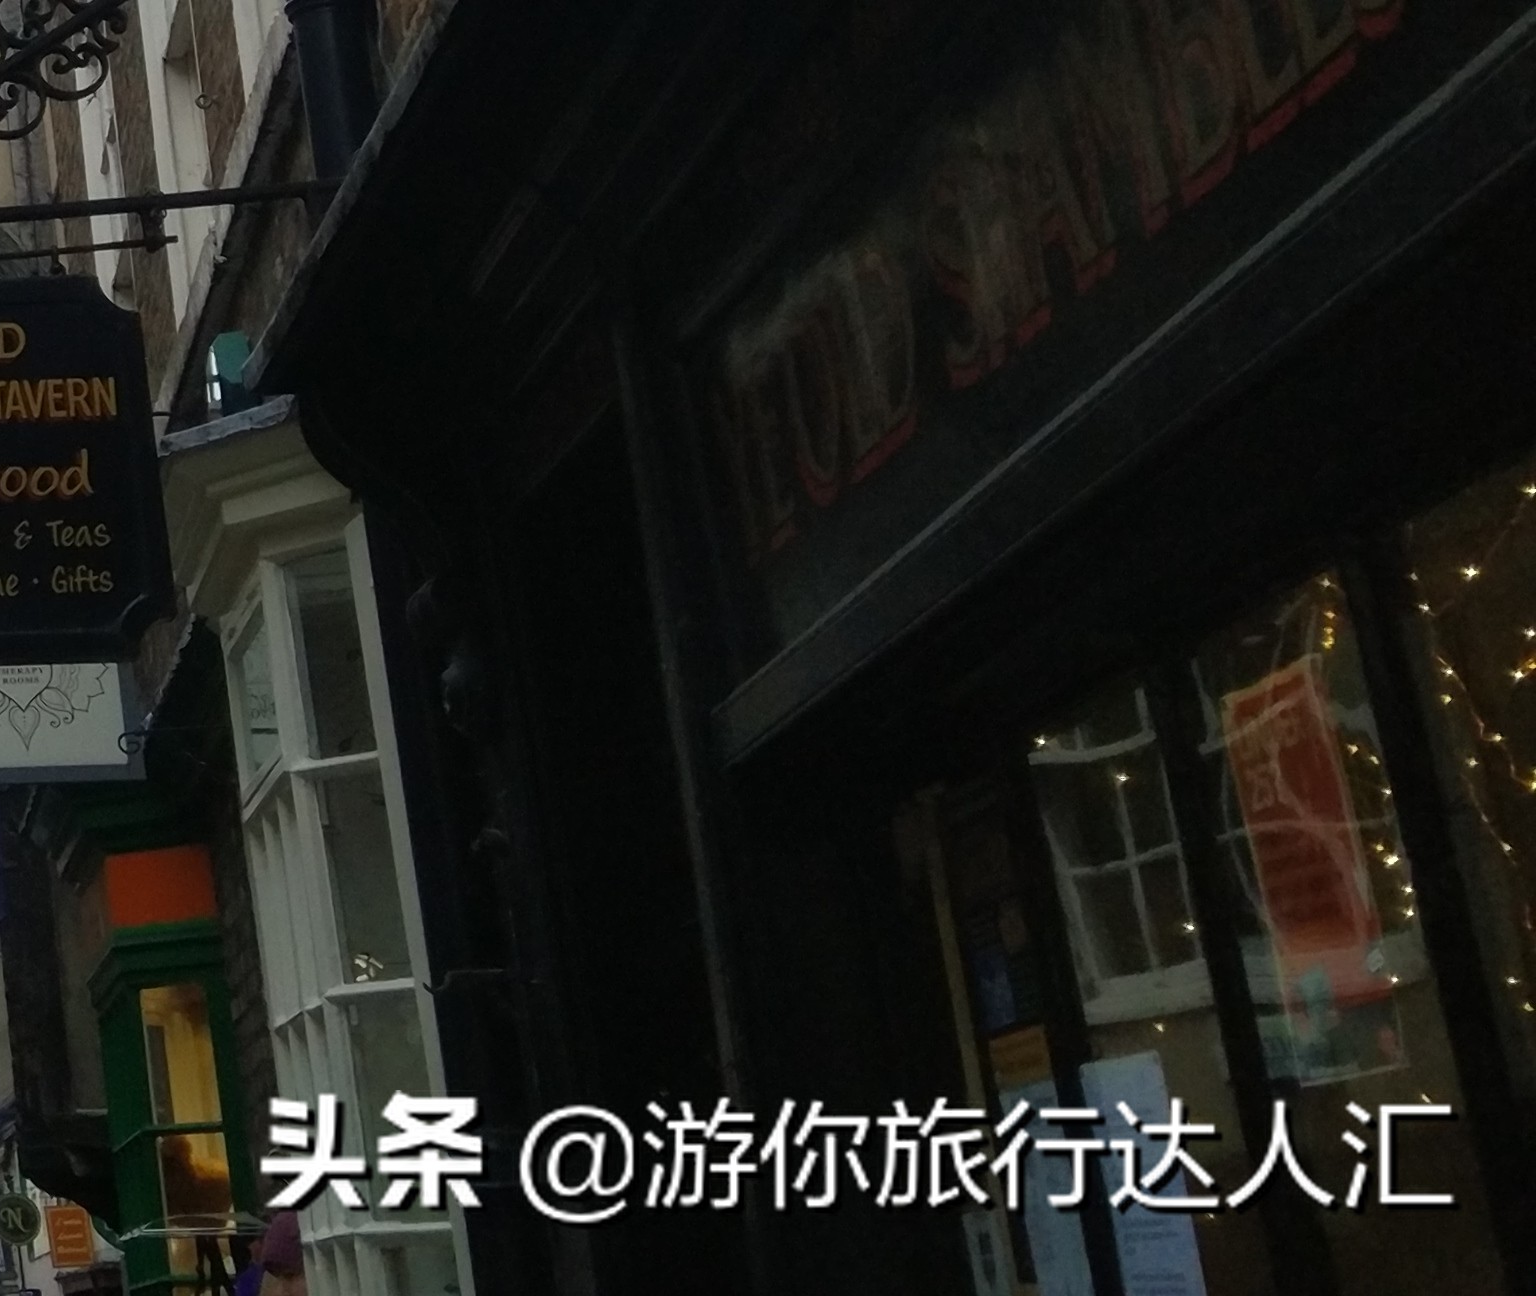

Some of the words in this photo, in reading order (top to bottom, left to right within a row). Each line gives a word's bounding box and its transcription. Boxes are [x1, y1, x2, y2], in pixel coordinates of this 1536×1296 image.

[14, 520, 31, 550] &
[46, 518, 111, 548] Teas
[50, 564, 115, 595] Gifts
